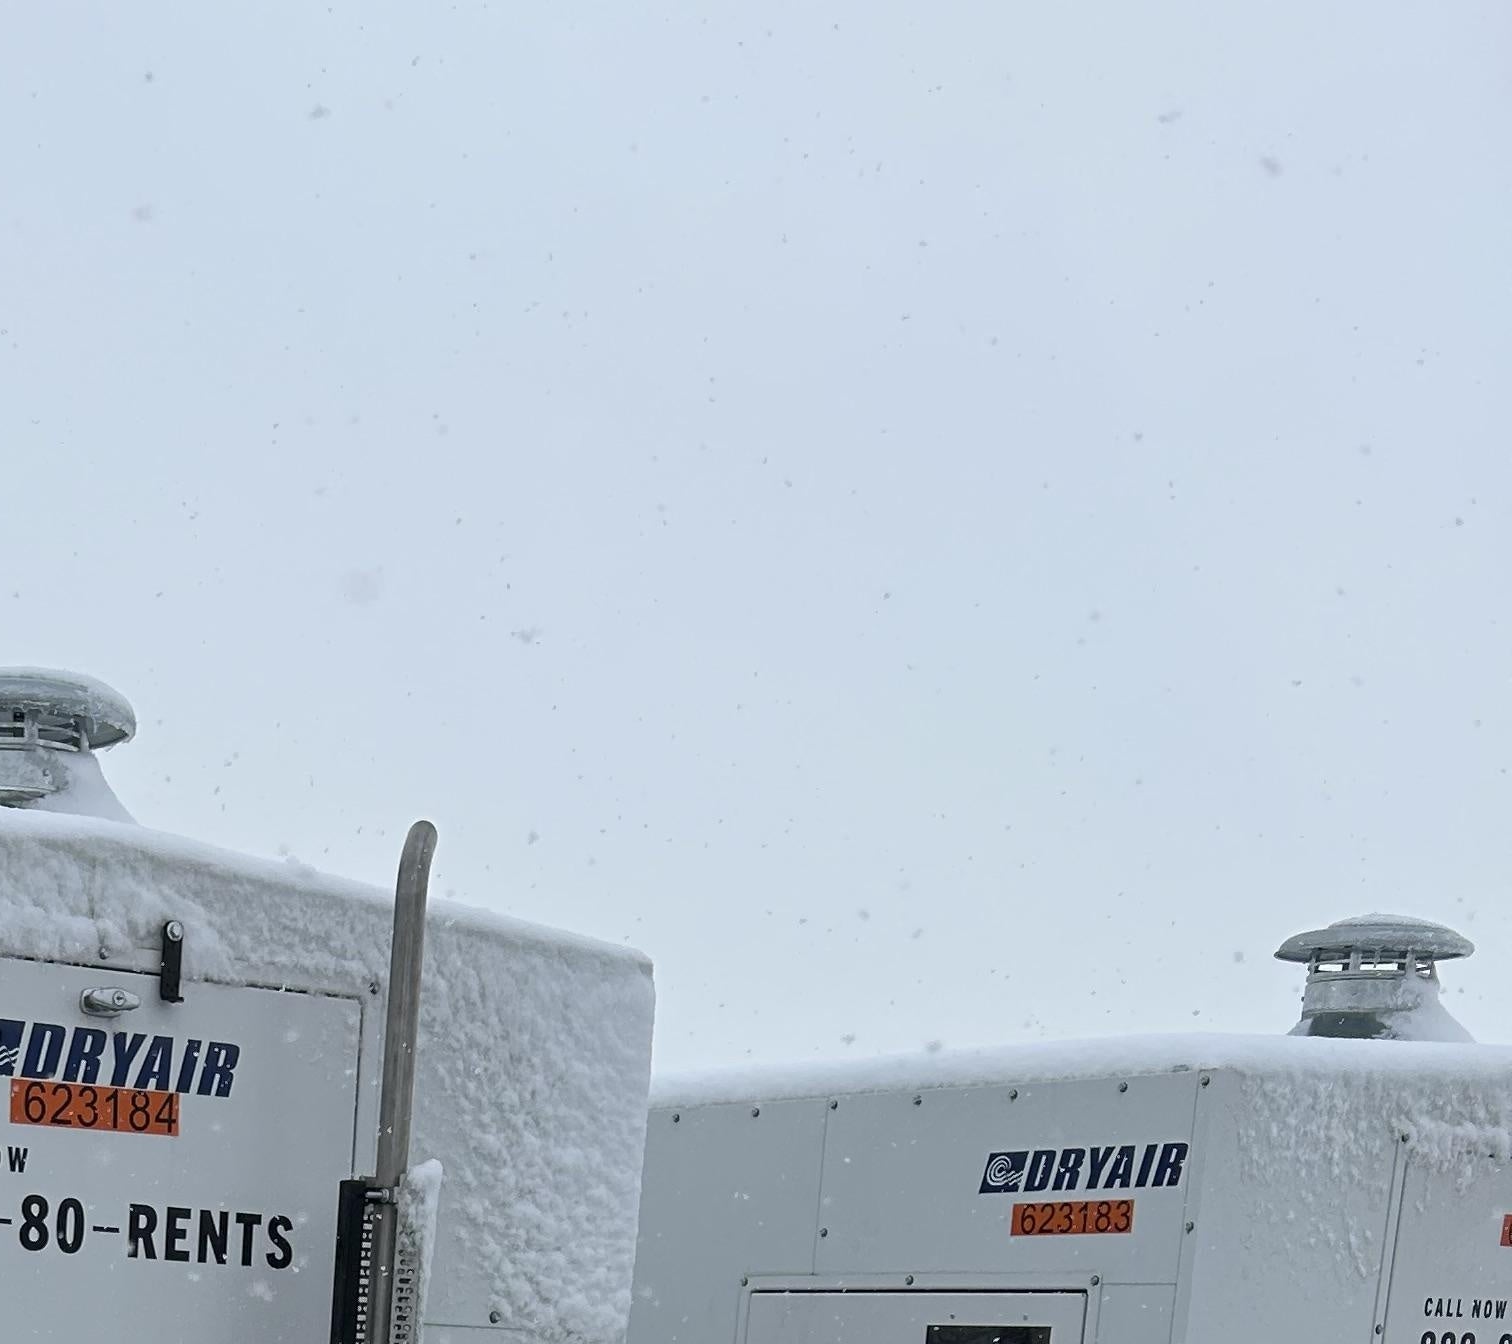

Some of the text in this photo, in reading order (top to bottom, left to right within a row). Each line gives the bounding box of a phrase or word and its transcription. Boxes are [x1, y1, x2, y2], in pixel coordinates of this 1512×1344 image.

[21, 1022, 240, 1098] DRYAIR
[24, 1081, 177, 1134] 623184
[1023, 1143, 1189, 1193] DRYAIR
[1020, 1200, 1131, 1235] 623183
[1424, 1298, 1508, 1320] CALL NOW
